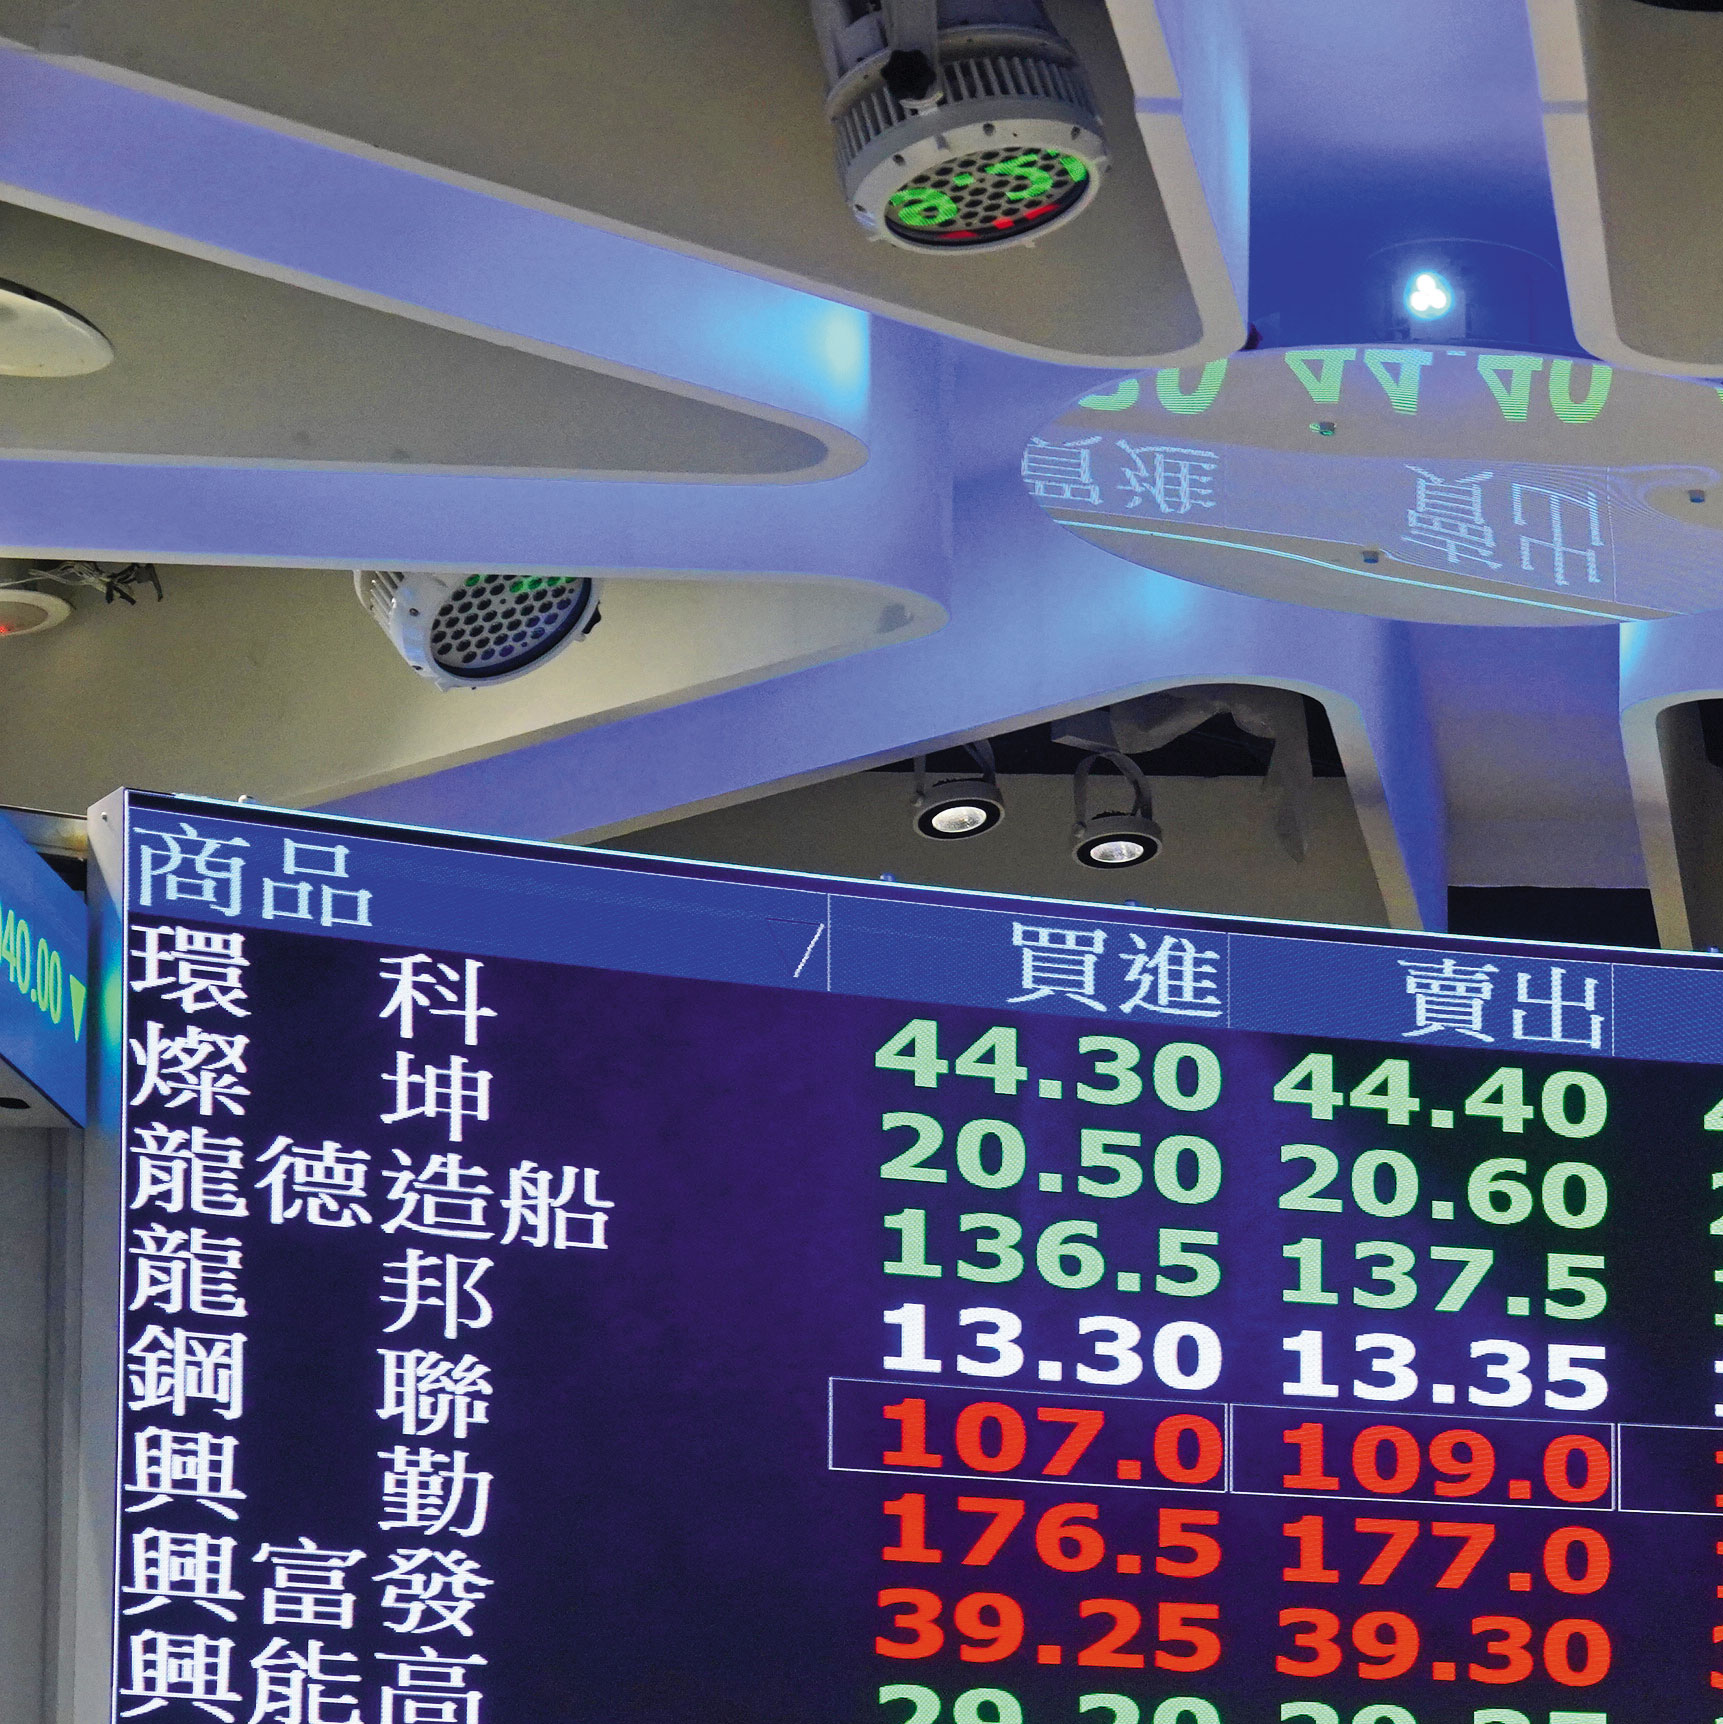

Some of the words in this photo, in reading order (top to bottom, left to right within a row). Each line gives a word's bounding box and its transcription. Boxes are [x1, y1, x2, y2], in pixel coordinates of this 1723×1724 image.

[131, 821, 374, 928] 商品
[1005, 919, 1226, 1021] 買進
[1395, 956, 1607, 1051] 賣出
[874, 1018, 1223, 1112] 44.30
[1272, 1052, 1608, 1139] 44.40
[129, 1121, 615, 1250] 龍德造船
[883, 1207, 1222, 1298] 136.5
[1282, 1237, 1608, 1320] 137.5
[883, 1302, 1223, 1391] 13.30
[1282, 1329, 1609, 1421] 13.35
[121, 1526, 495, 1637] 興富發
[881, 1492, 1223, 1579] 176.5
[1282, 1514, 1612, 1596] 177.0
